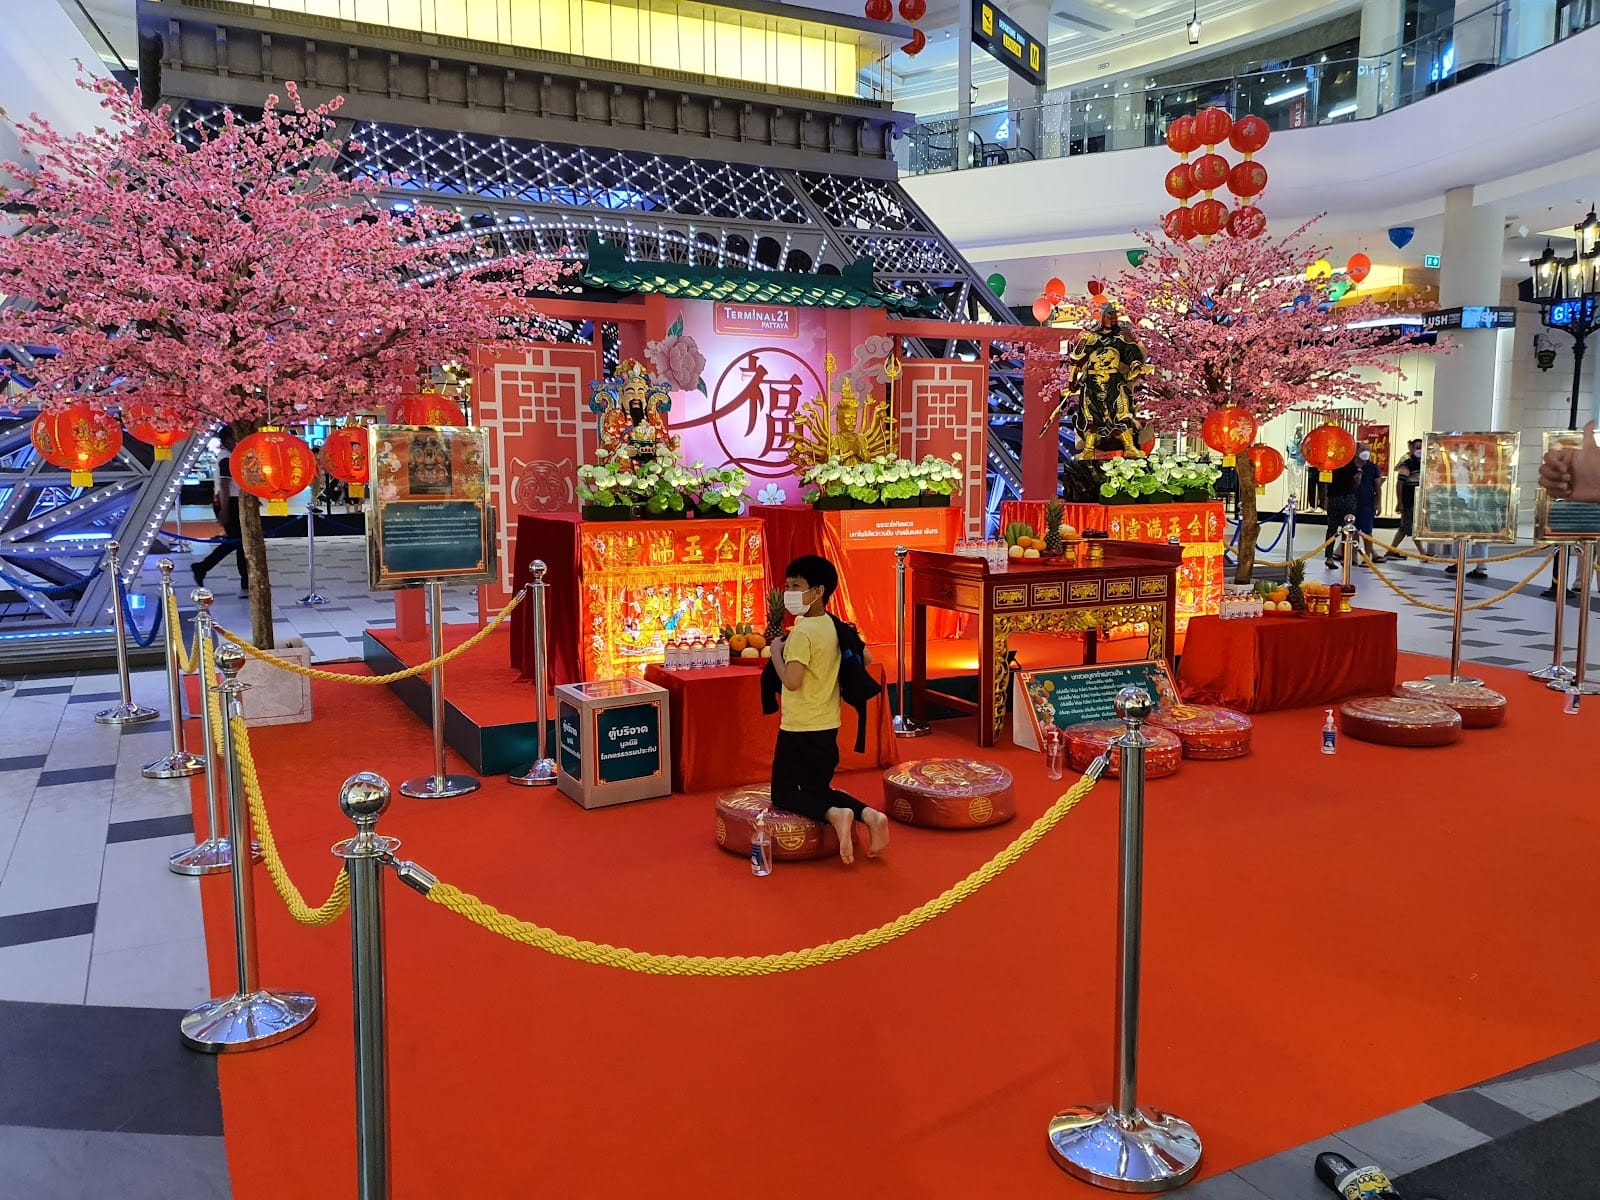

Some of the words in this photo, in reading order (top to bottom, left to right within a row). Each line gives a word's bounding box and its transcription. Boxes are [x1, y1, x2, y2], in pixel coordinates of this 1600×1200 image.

[1294, 102, 1302, 127] SALE
[761, 321, 788, 329] PATTAYA
[608, 725, 649, 741] ตู้บริจาค
